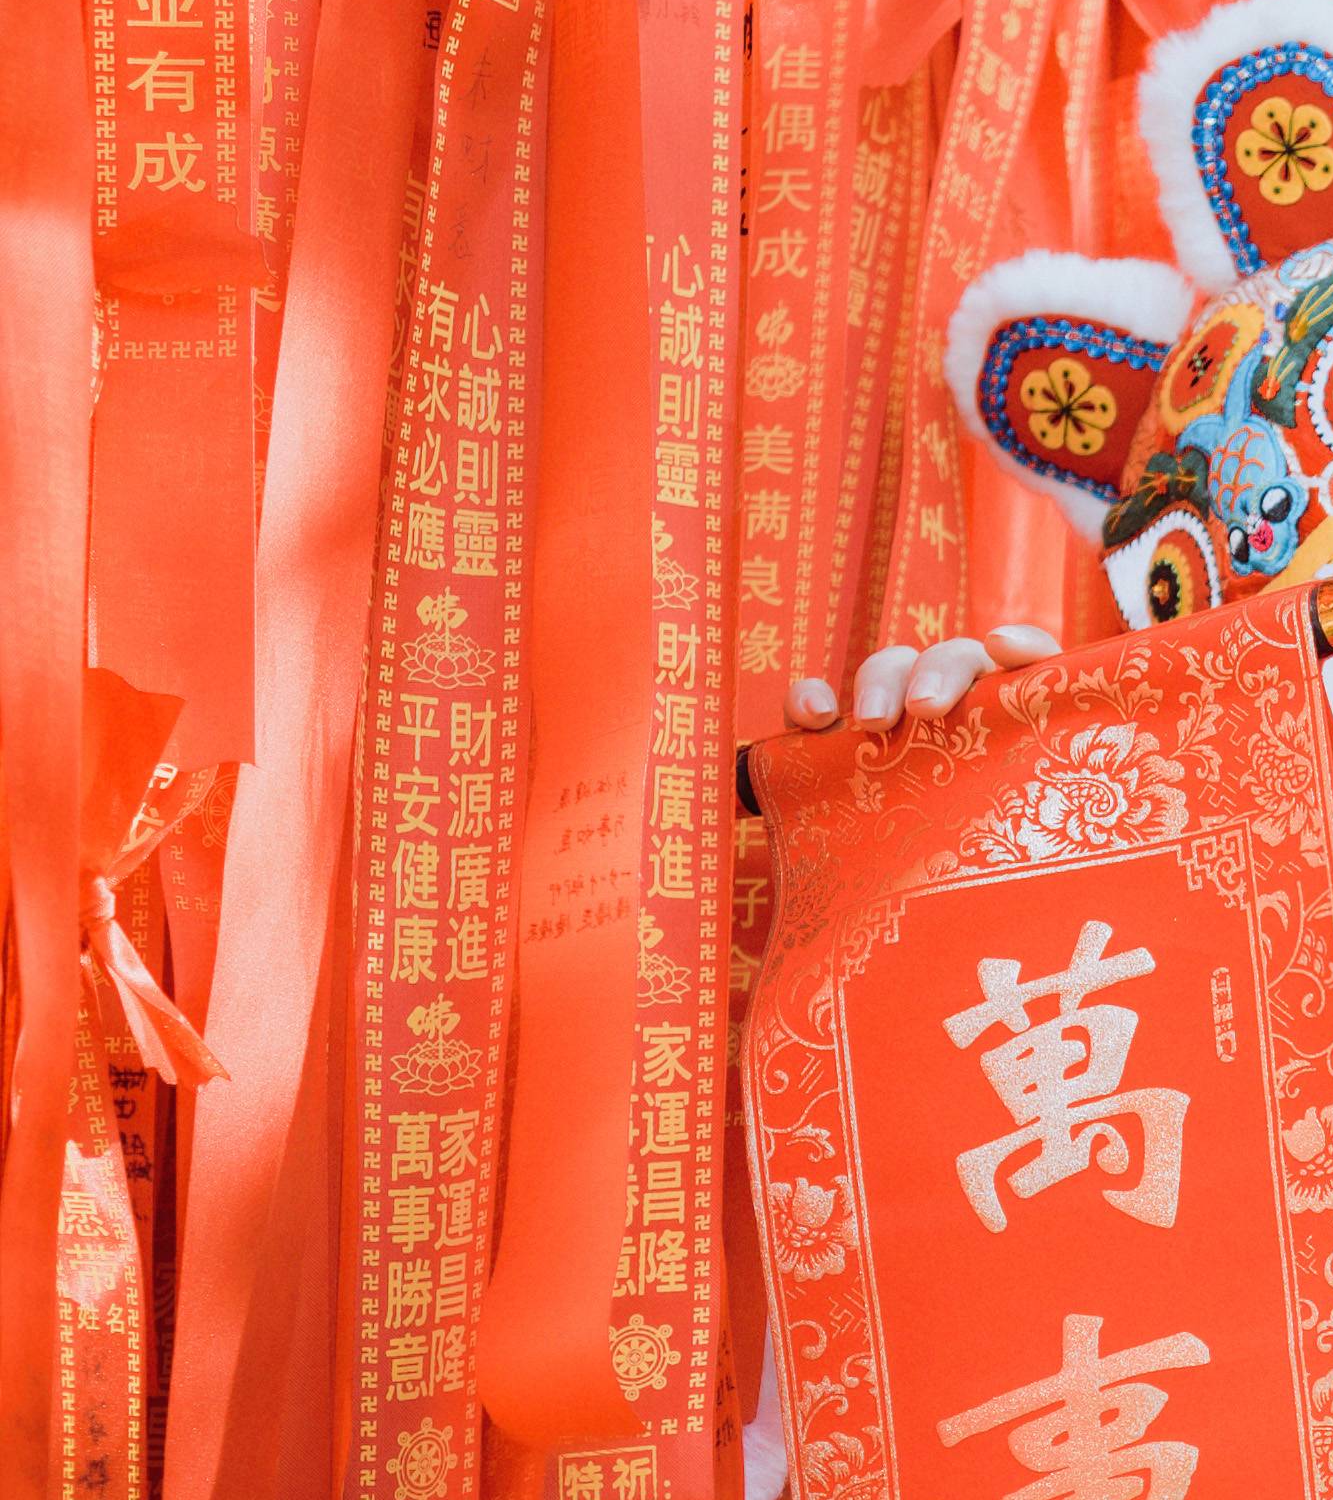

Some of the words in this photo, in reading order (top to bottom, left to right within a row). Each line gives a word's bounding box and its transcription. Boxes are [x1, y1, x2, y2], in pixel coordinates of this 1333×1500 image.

[749, 42, 823, 282] 佳偶天成
[402, 280, 459, 573] 有求必應
[450, 293, 504, 578] 心誠則靈
[655, 234, 706, 510] 心誠則靈
[391, 693, 442, 986] 平安健康
[444, 700, 498, 984] 財源廣進
[646, 620, 703, 898] 財源廣進
[385, 1109, 438, 1405] 萬事勝意
[430, 1107, 482, 1398] 家運昌隆
[638, 1020, 693, 1298] 家運昌隆
[77, 1304, 126, 1334] 姓名
